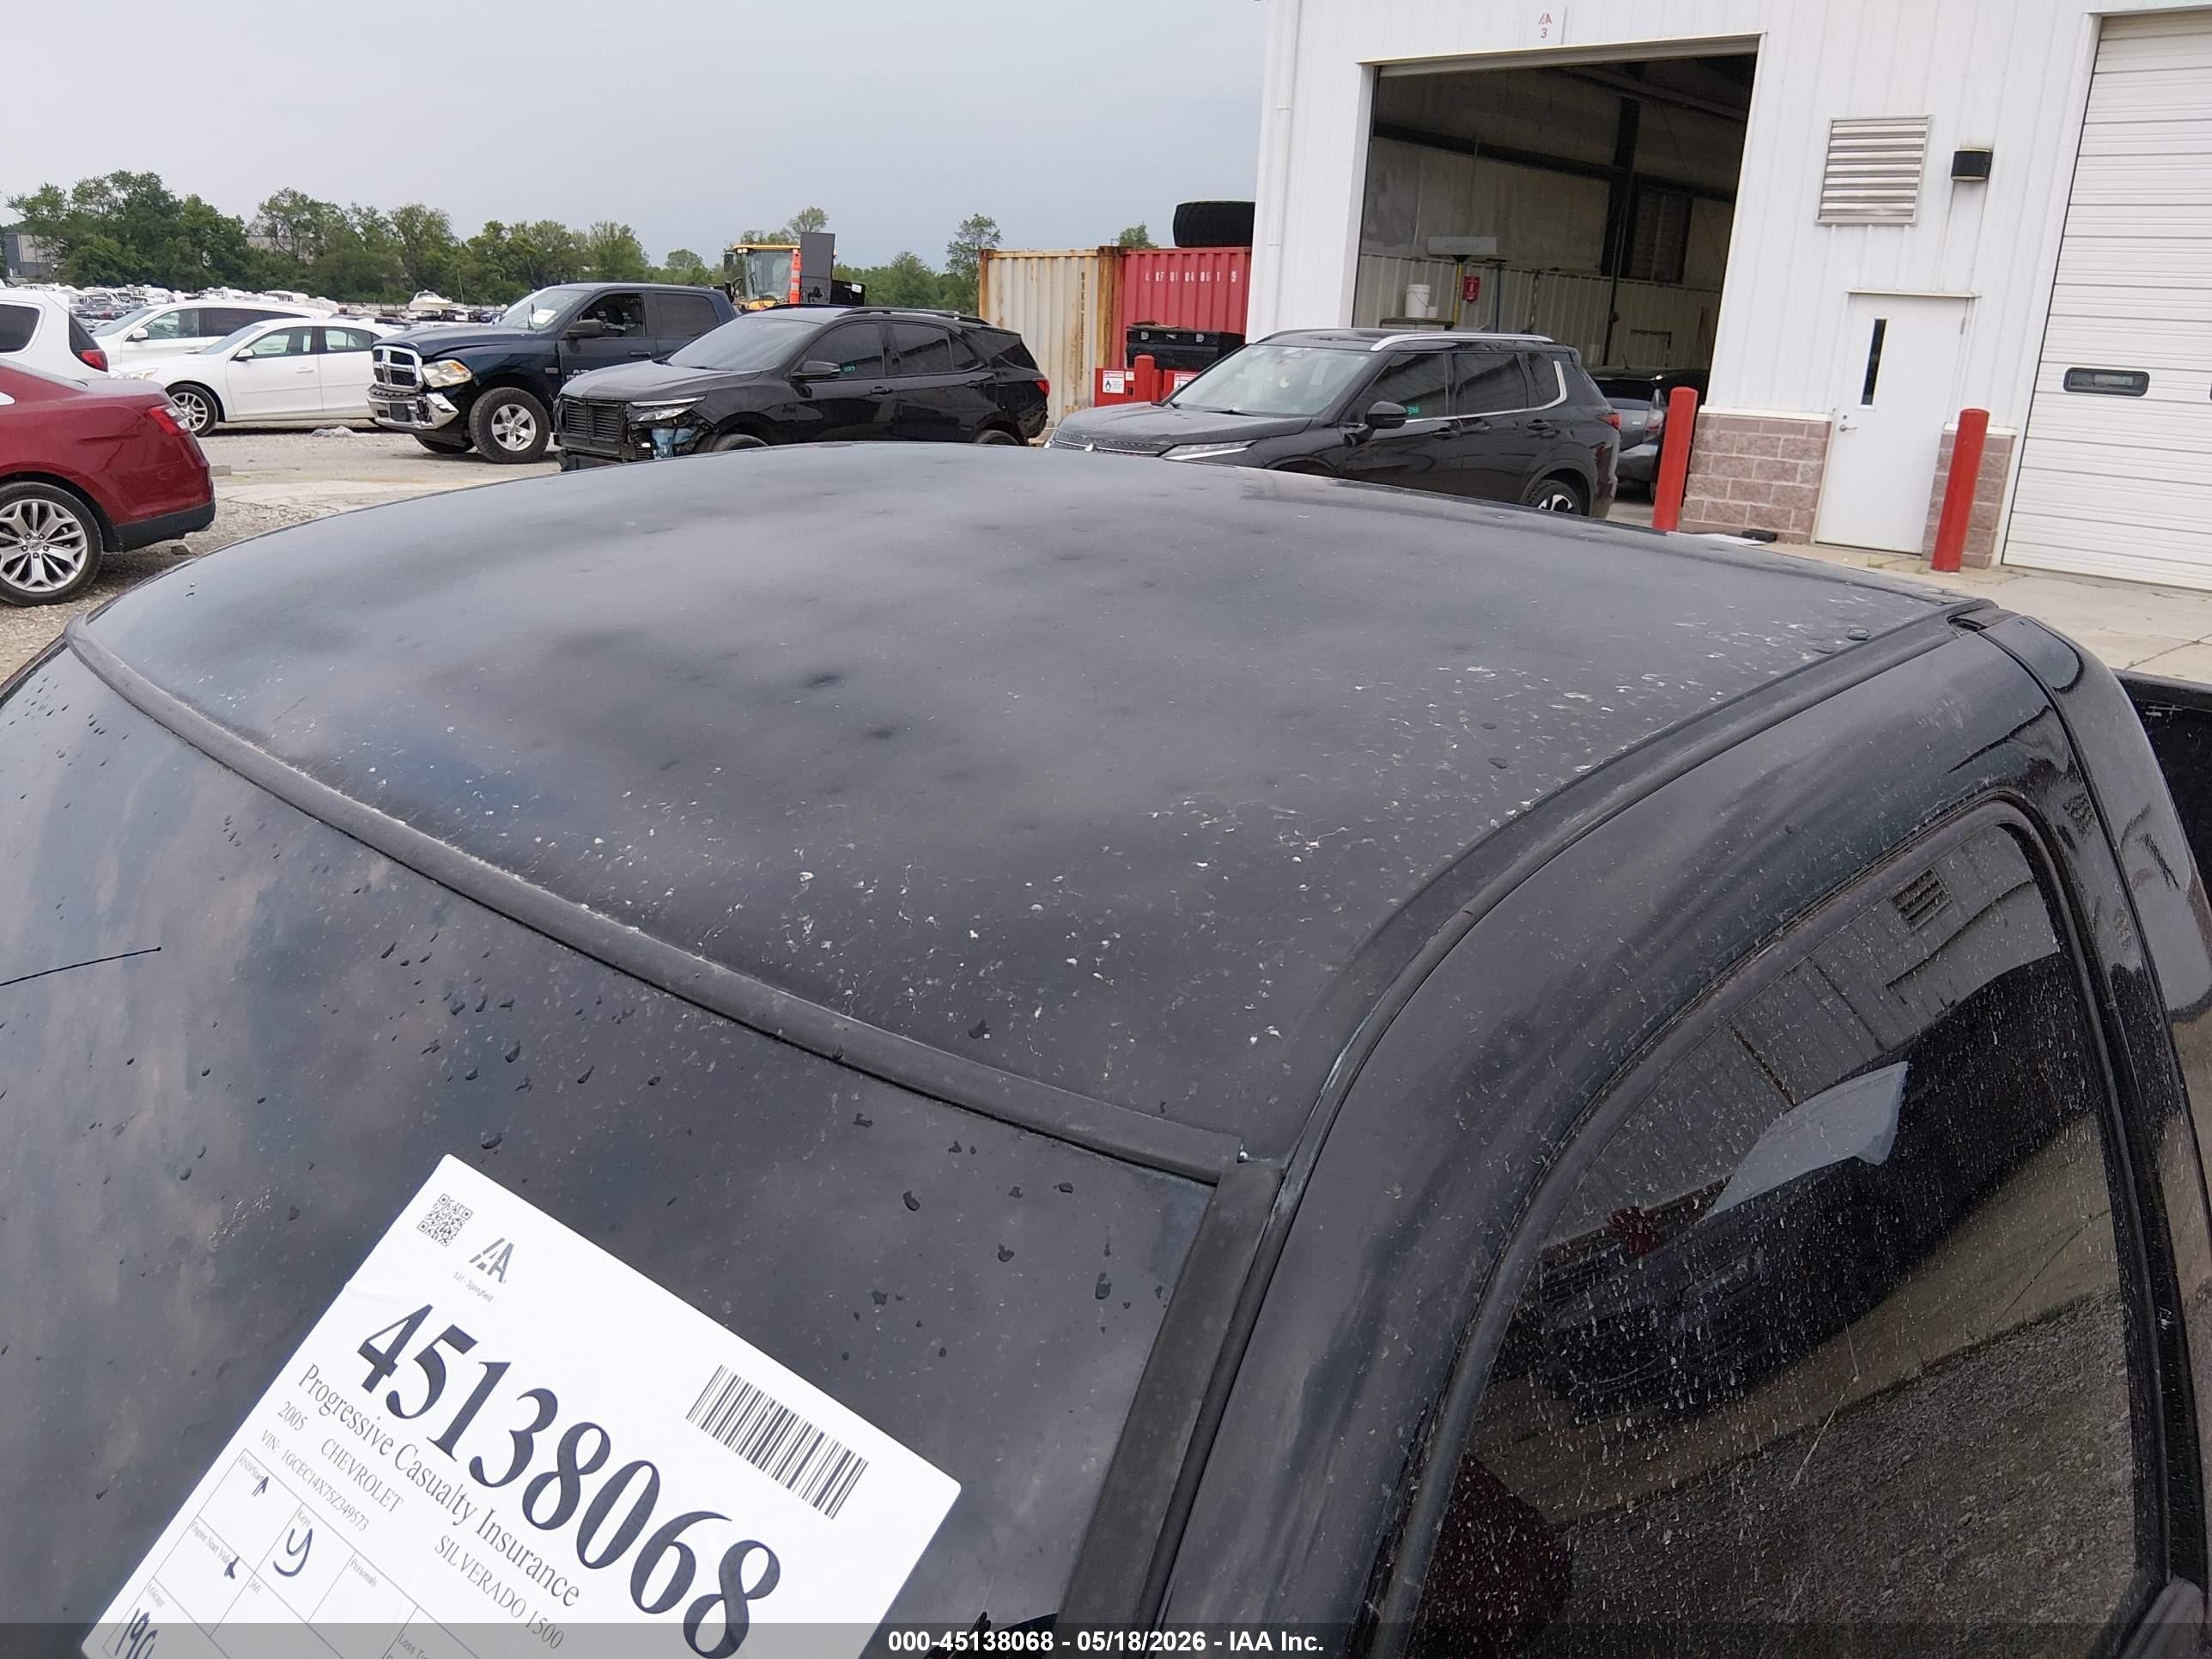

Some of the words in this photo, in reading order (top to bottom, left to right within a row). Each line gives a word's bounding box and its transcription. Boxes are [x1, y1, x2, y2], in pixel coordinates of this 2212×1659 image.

[1540, 27, 1547, 39] 3
[261, 1429, 280, 1451] VIN:
[276, 1401, 307, 1431] 2005
[320, 1438, 404, 1513] CHEVROLET
[434, 1534, 527, 1619] SILVERADO
[525, 1610, 564, 1650] 1500
[298, 1363, 394, 1456] Progressive
[394, 1443, 477, 1527] Casualty
[475, 1508, 580, 1607] Insurance
[356, 1304, 781, 1659] 45138068
